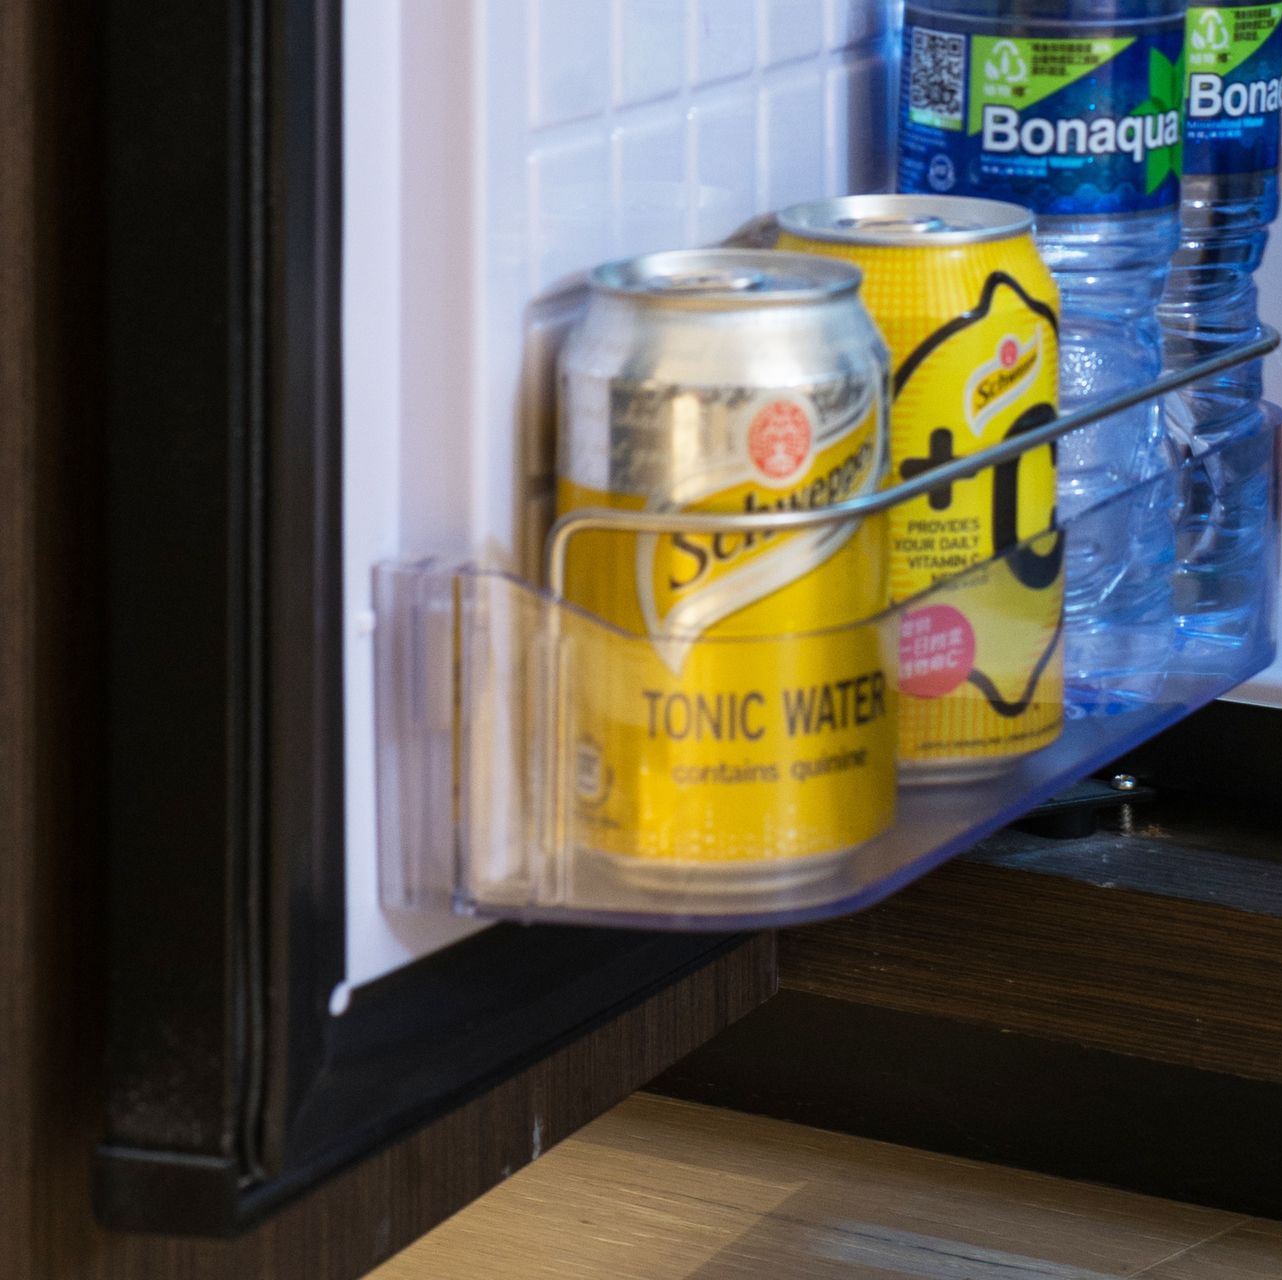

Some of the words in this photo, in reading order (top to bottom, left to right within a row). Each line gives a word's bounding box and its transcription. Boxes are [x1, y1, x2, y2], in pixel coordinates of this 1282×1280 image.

[981, 103, 1178, 162] Bonaqua
[907, 518, 979, 534] PROVIDES
[894, 537, 935, 553] YOUR
[939, 535, 979, 551] DAILY
[908, 554, 967, 569] VITAMIN
[641, 689, 768, 742] TONIC
[782, 668, 887, 738] WATER
[671, 753, 780, 787] contains
[789, 746, 870, 783] quinine
